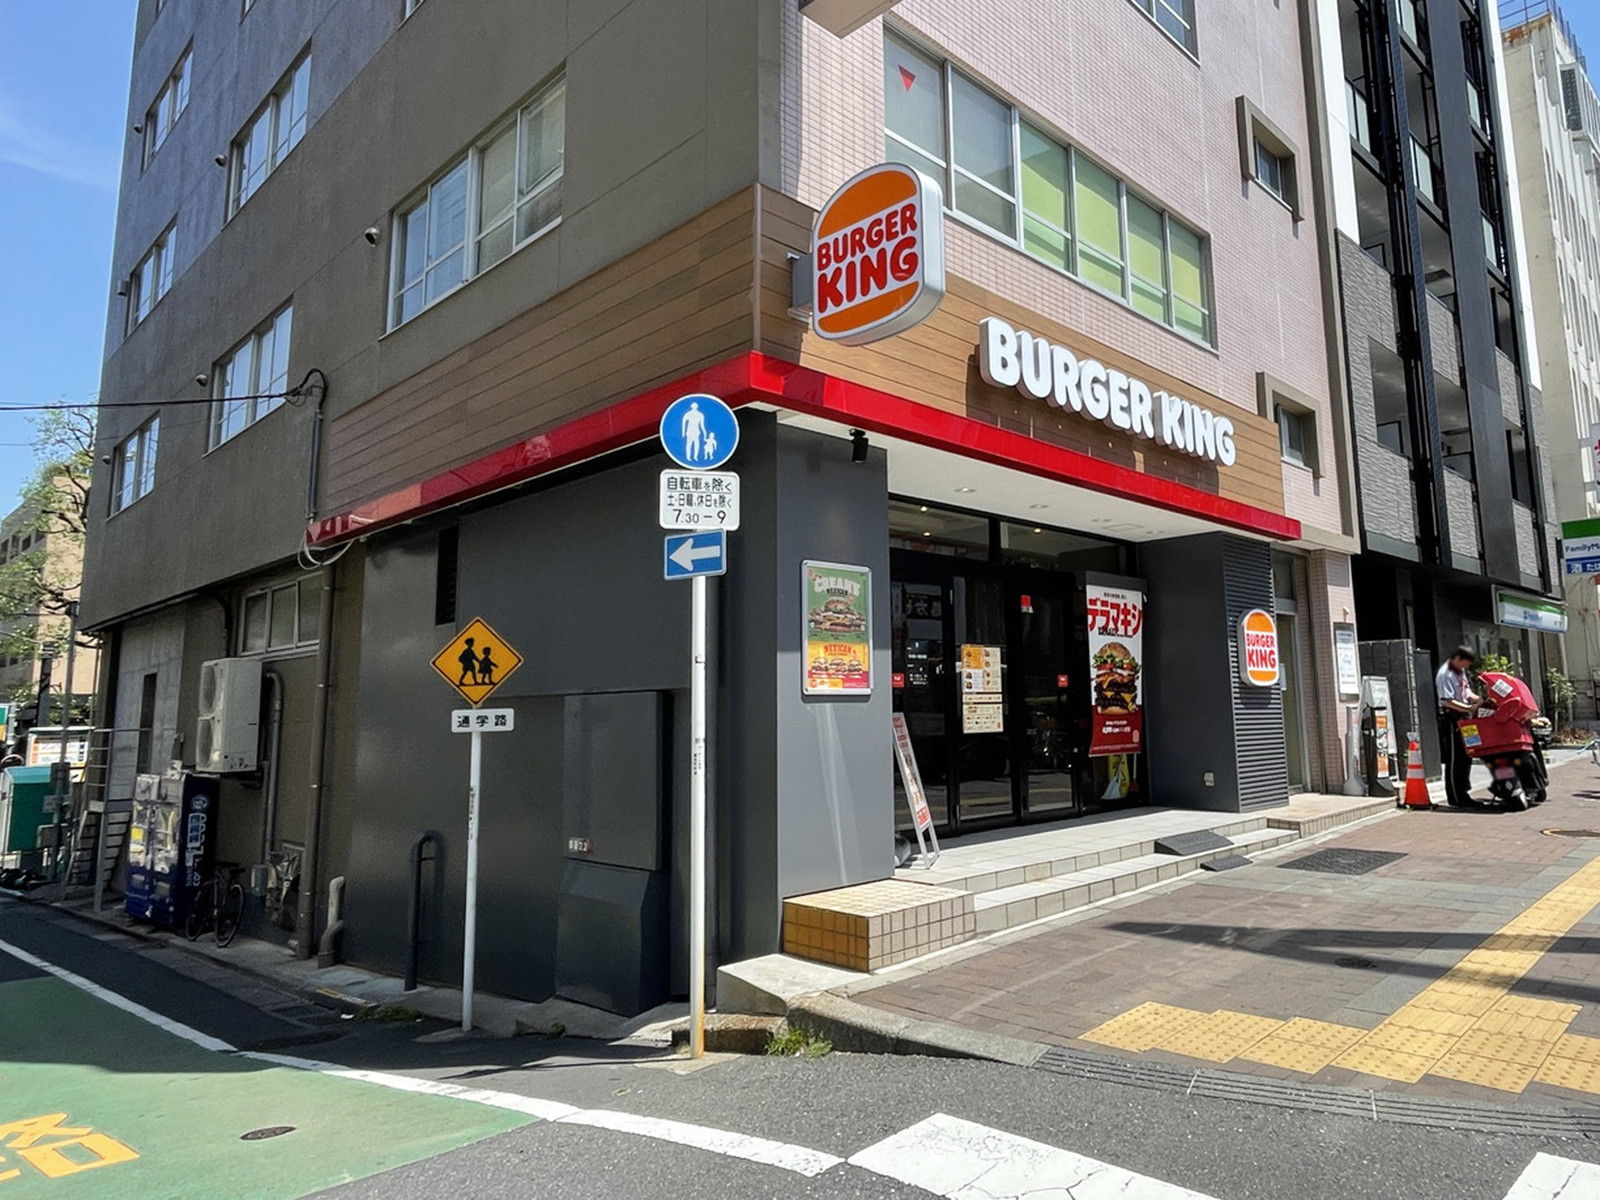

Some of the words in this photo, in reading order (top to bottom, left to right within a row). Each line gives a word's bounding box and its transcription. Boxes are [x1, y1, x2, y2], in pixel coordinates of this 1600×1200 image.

[817, 203, 917, 272] BURGER
[818, 236, 919, 314] KING
[980, 316, 1154, 439] BURGER
[1153, 391, 1236, 467] KING
[667, 476, 732, 492] 自転車を除く
[1246, 633, 1275, 649] BURGER
[1247, 649, 1276, 669] KING
[457, 714, 507, 728] 通学路
